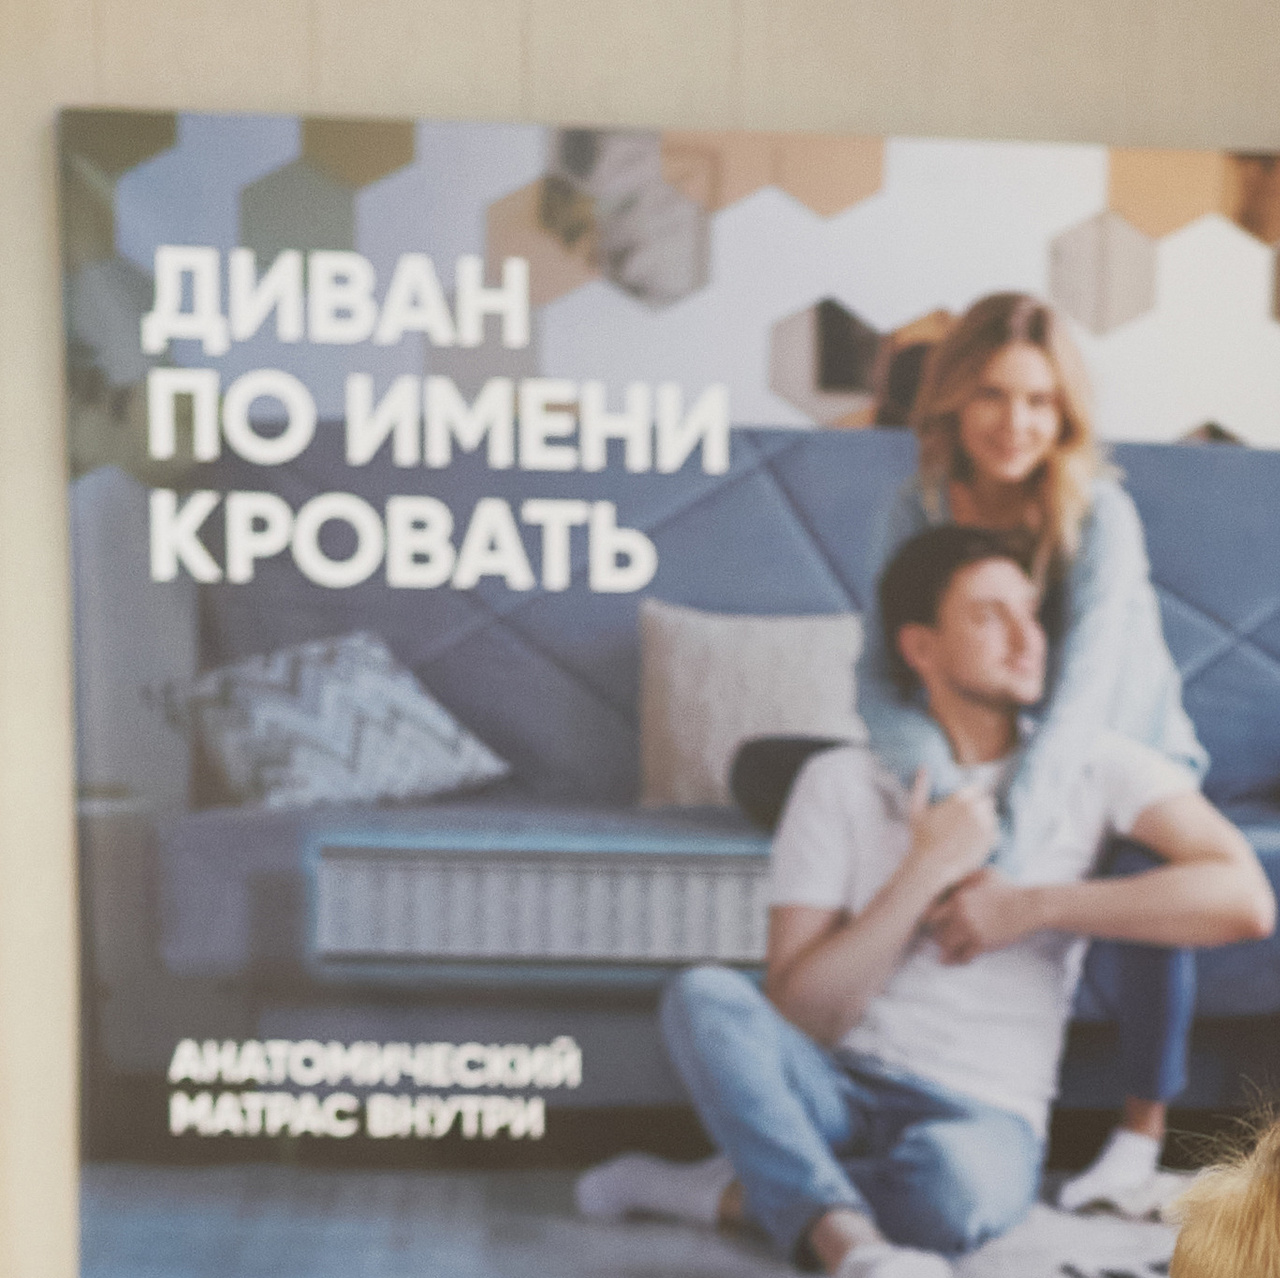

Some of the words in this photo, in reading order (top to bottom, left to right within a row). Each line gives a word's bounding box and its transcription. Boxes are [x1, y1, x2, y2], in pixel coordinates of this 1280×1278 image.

[141, 246, 531, 356] ДИВАН
[147, 368, 318, 465] ПО
[345, 372, 730, 476] ИМЕНИ
[148, 488, 658, 593] КРОВАТЬ
[168, 1035, 583, 1088] АНАТОМИЧЕСКИЙ
[168, 1091, 360, 1138] МАТРАС
[366, 1094, 546, 1140] ВНУТРИ
